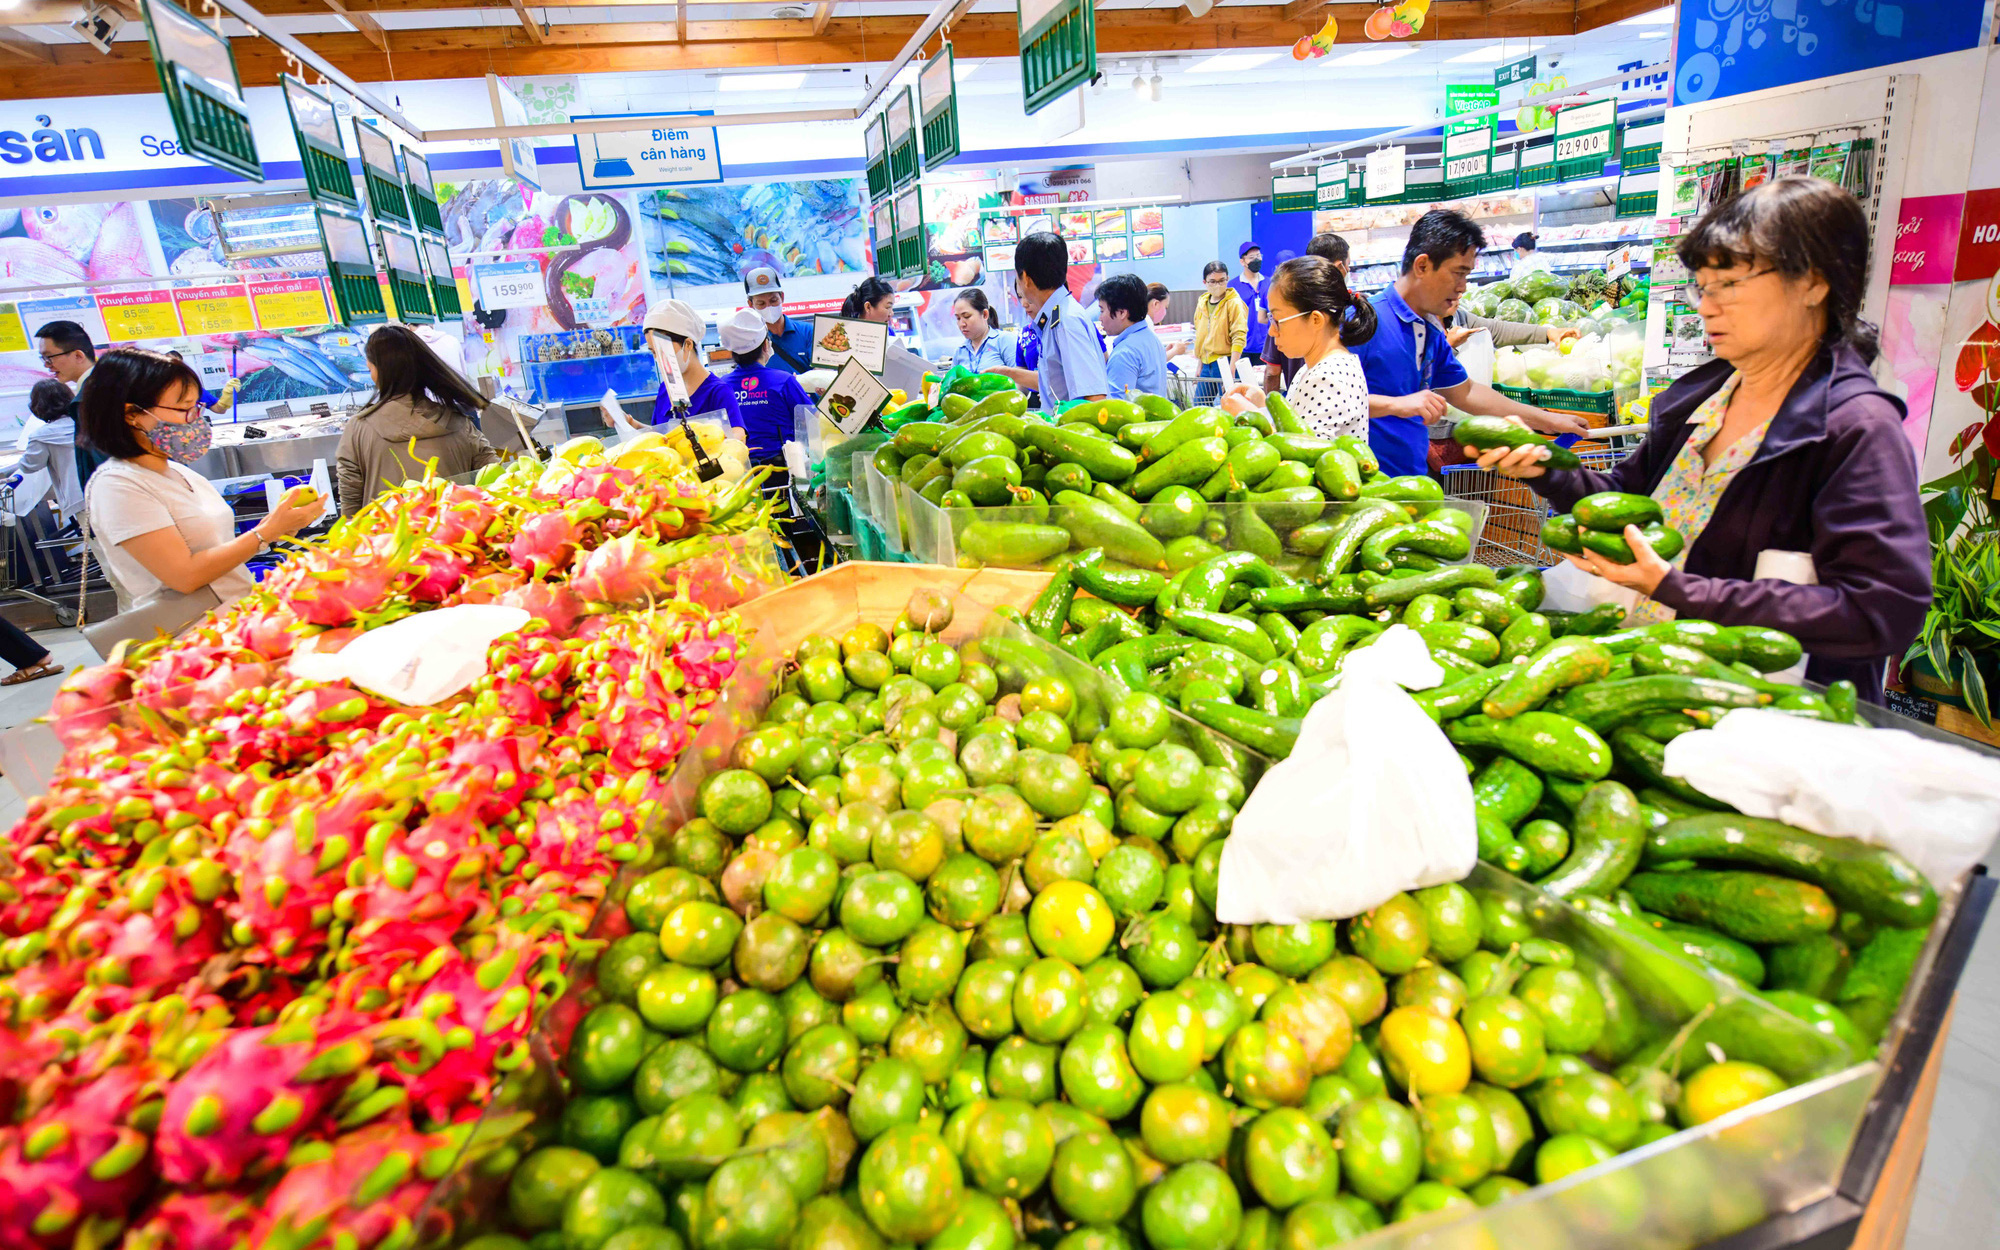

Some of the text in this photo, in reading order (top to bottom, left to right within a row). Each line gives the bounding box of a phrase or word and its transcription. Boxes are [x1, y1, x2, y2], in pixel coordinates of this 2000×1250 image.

[1498, 71, 1510, 81] EXIT
[1454, 99, 1490, 110] VietGAP
[0, 114, 105, 164] sản
[1558, 136, 1599, 156] 22.900
[640, 146, 706, 161] cân hàng
[1449, 159, 1479, 176] 17.900
[1024, 194, 1059, 205] SASHIMI
[1972, 224, 2000, 244] HO
[1893, 250, 1926, 272] ơng
[176, 288, 228, 300] Khuyến mãi
[251, 282, 302, 295] Khuyến mãi
[99, 294, 153, 307] Khuyến mãi
[339, 337, 349, 345] 24
